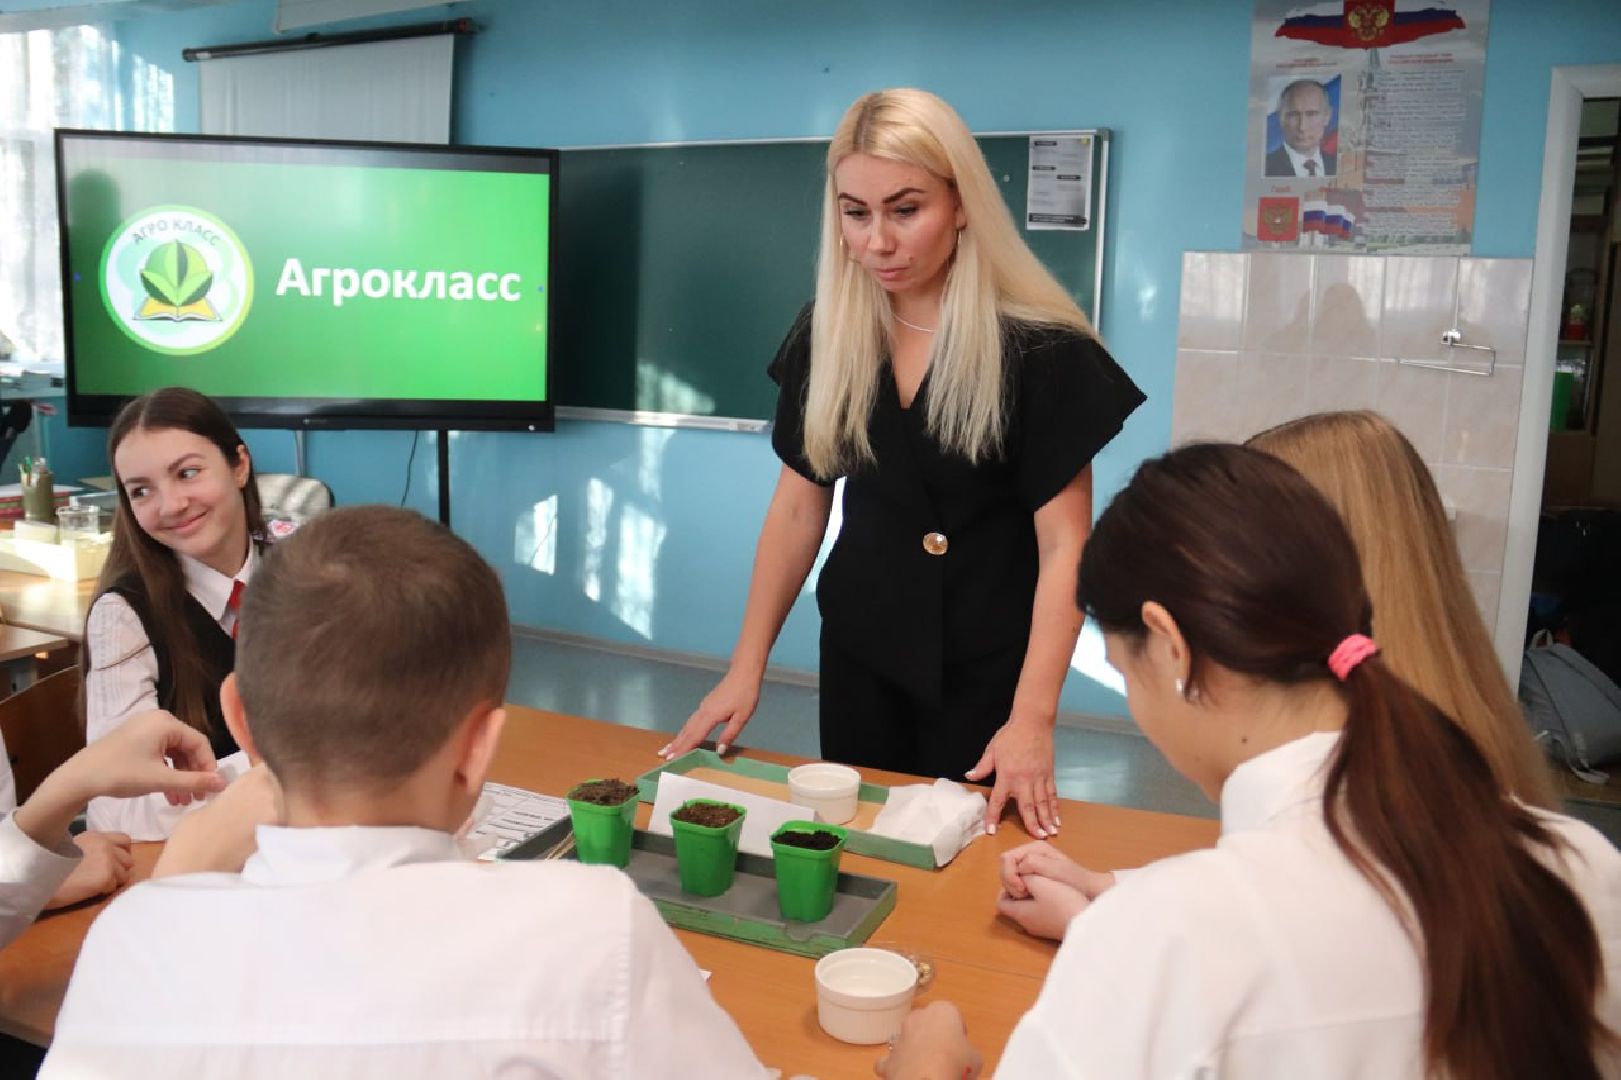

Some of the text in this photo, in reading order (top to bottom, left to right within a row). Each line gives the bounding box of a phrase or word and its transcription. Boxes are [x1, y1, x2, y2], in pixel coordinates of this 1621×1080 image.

[132, 219, 221, 246] АГРО КЛАСС
[276, 258, 521, 307] Агрокласс
